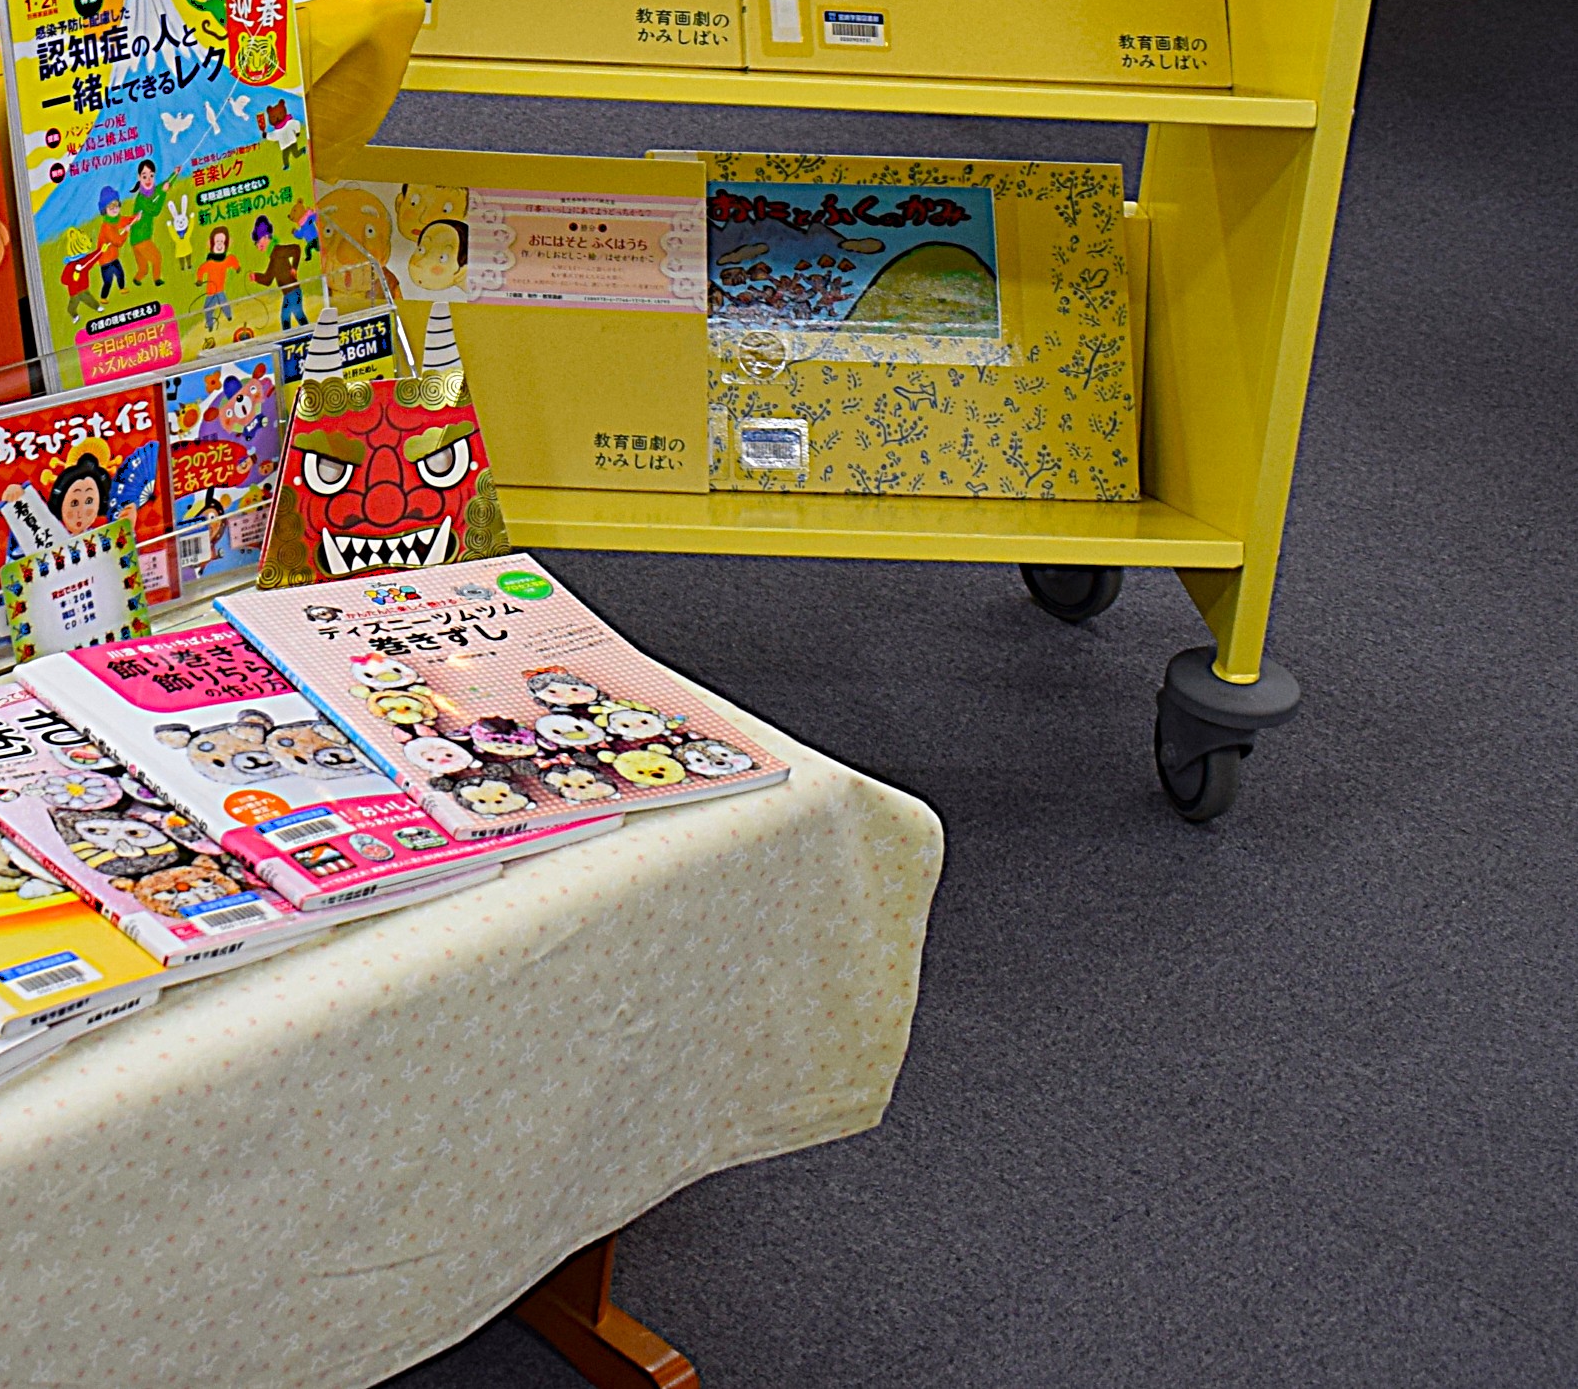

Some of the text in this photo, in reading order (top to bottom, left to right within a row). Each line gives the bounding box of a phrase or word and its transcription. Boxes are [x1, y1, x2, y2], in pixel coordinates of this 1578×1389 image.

[636, 7, 730, 30] 教育画劇の
[36, 13, 198, 81] 認知症の人と
[636, 28, 729, 47] かみしばい
[1118, 33, 1208, 53] 教育画劇の
[1122, 53, 1208, 71] かみしばい
[593, 432, 686, 453] 教育画劇の
[594, 452, 684, 471] かみしばい
[369, 624, 509, 656] 巻きずし
